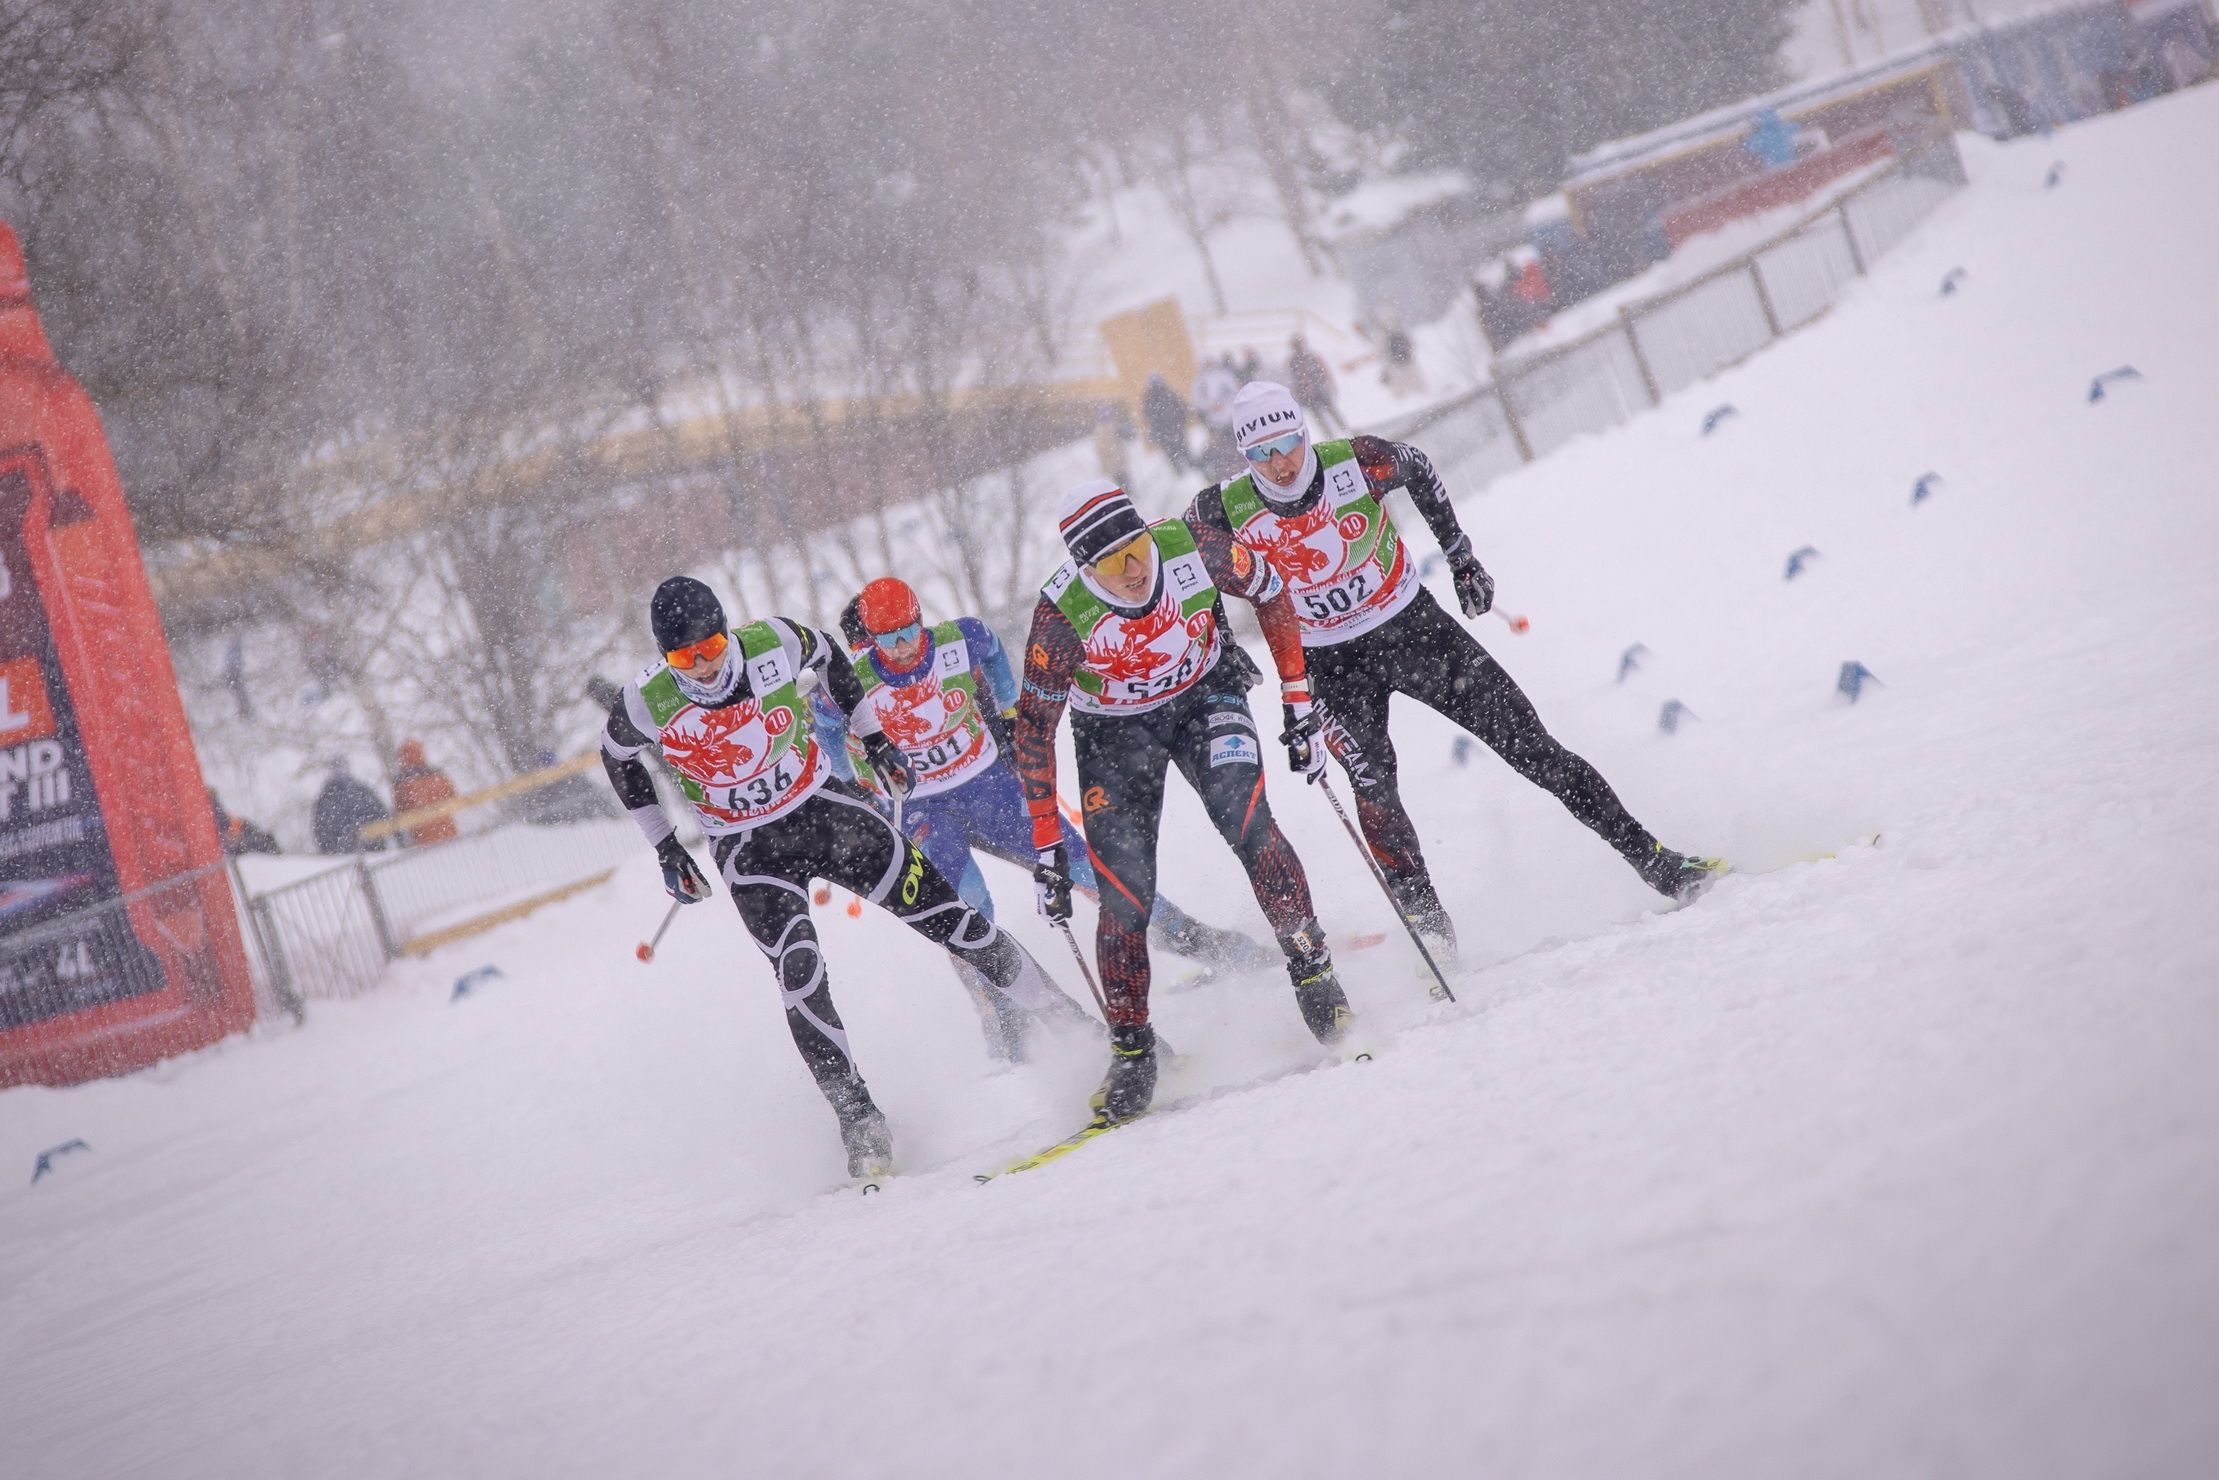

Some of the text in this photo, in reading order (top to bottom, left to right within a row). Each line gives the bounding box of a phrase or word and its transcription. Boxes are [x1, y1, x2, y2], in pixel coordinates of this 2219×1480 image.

[1343, 515, 1362, 534] 10
[1303, 574, 1374, 620] 502
[946, 691, 962, 709] 10
[768, 709, 788, 730] 10
[908, 735, 962, 772] 501
[1211, 749, 1257, 762] АСПЕКТ
[728, 763, 793, 811] 636
[1297, 936, 1310, 951] 520
